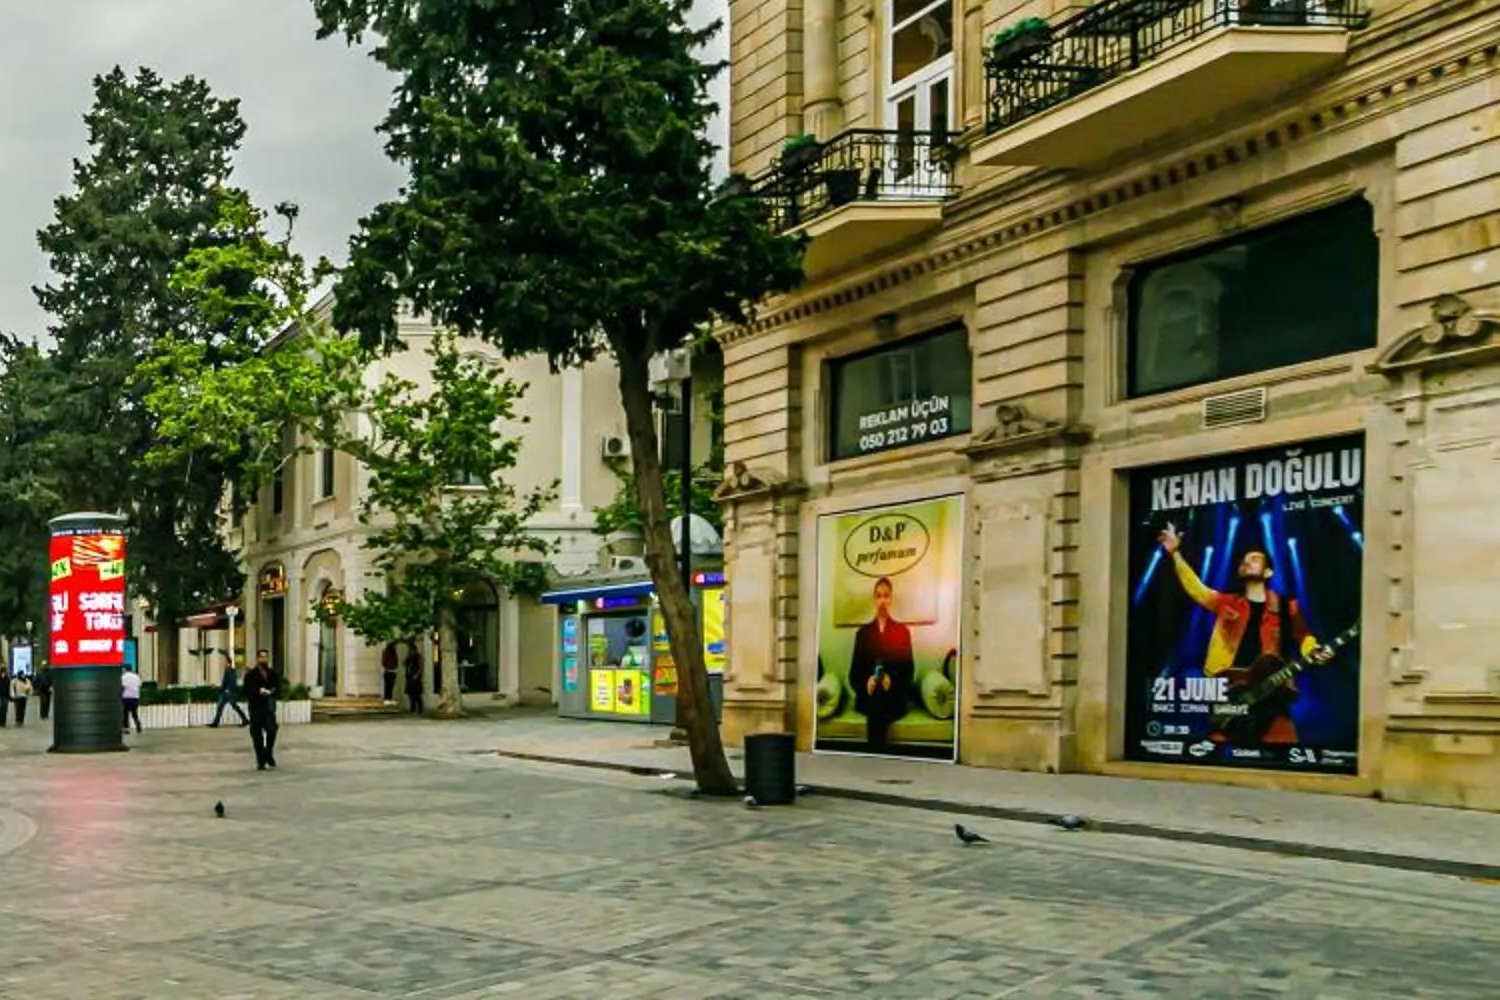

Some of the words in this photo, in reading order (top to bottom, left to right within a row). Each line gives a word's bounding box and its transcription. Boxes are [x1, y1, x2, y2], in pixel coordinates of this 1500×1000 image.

[860, 406, 909, 430] REKLAM
[911, 395, 949, 419] ÜÇÜN
[860, 432, 885, 451] 050
[887, 427, 908, 445] 212
[911, 422, 927, 439] 79
[930, 417, 949, 435] 03
[1151, 467, 1237, 511] KENAN
[1245, 448, 1362, 499] DOĞULU
[869, 522, 906, 542] D&P
[1154, 677, 1175, 700] 21
[1179, 677, 1229, 702] JUNE
